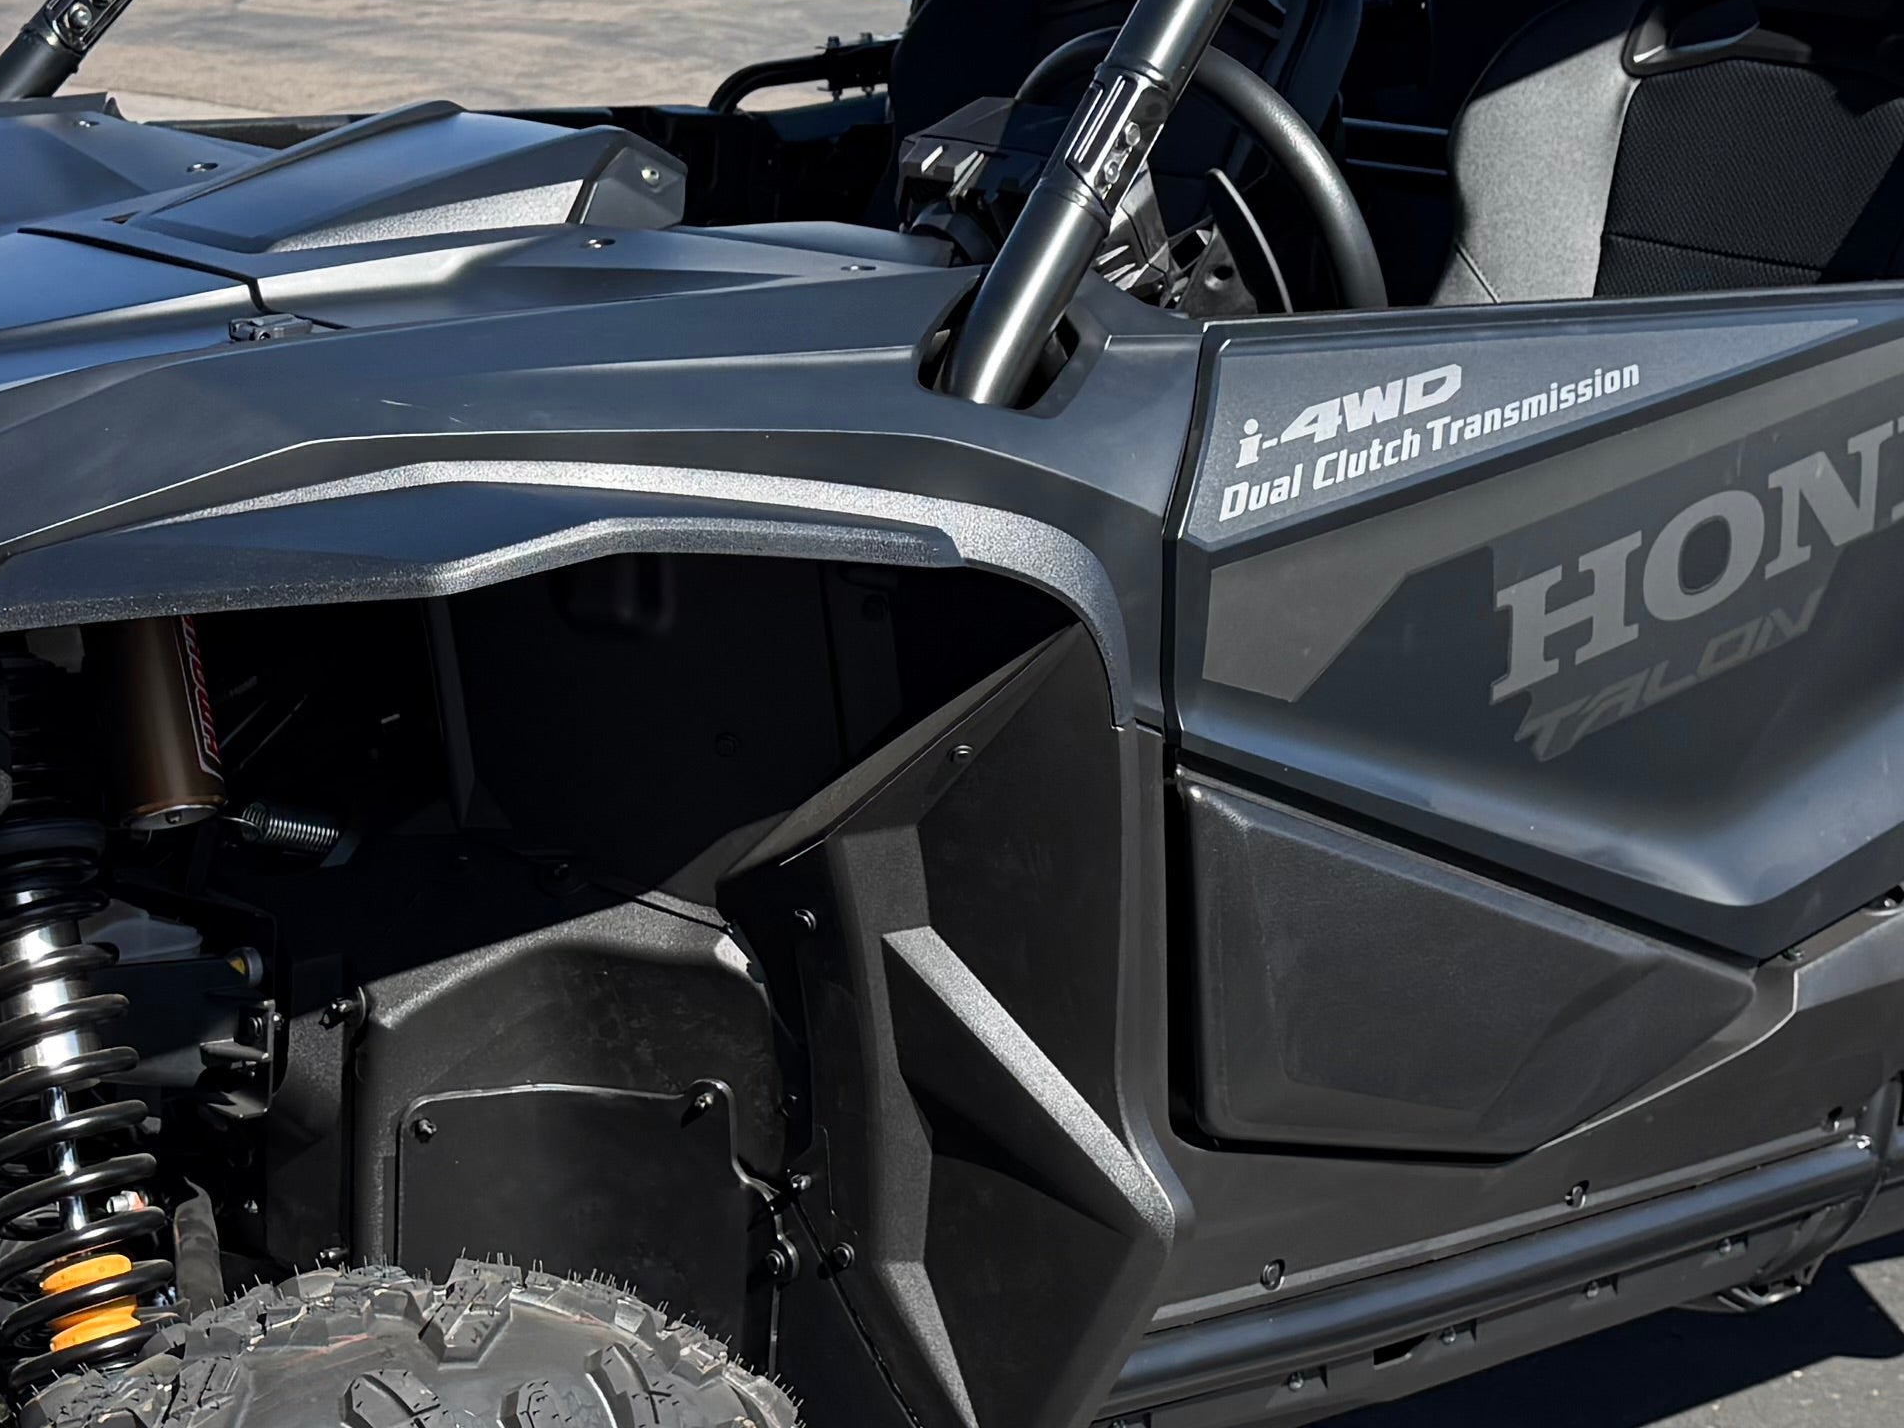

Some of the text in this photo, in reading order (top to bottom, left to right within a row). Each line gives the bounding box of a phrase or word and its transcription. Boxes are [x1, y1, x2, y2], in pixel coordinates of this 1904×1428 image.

[1219, 363, 1640, 522] Dual Clutch Transmission
[1235, 363, 1462, 469] i-4WD
[1514, 585, 1826, 762] TALON
